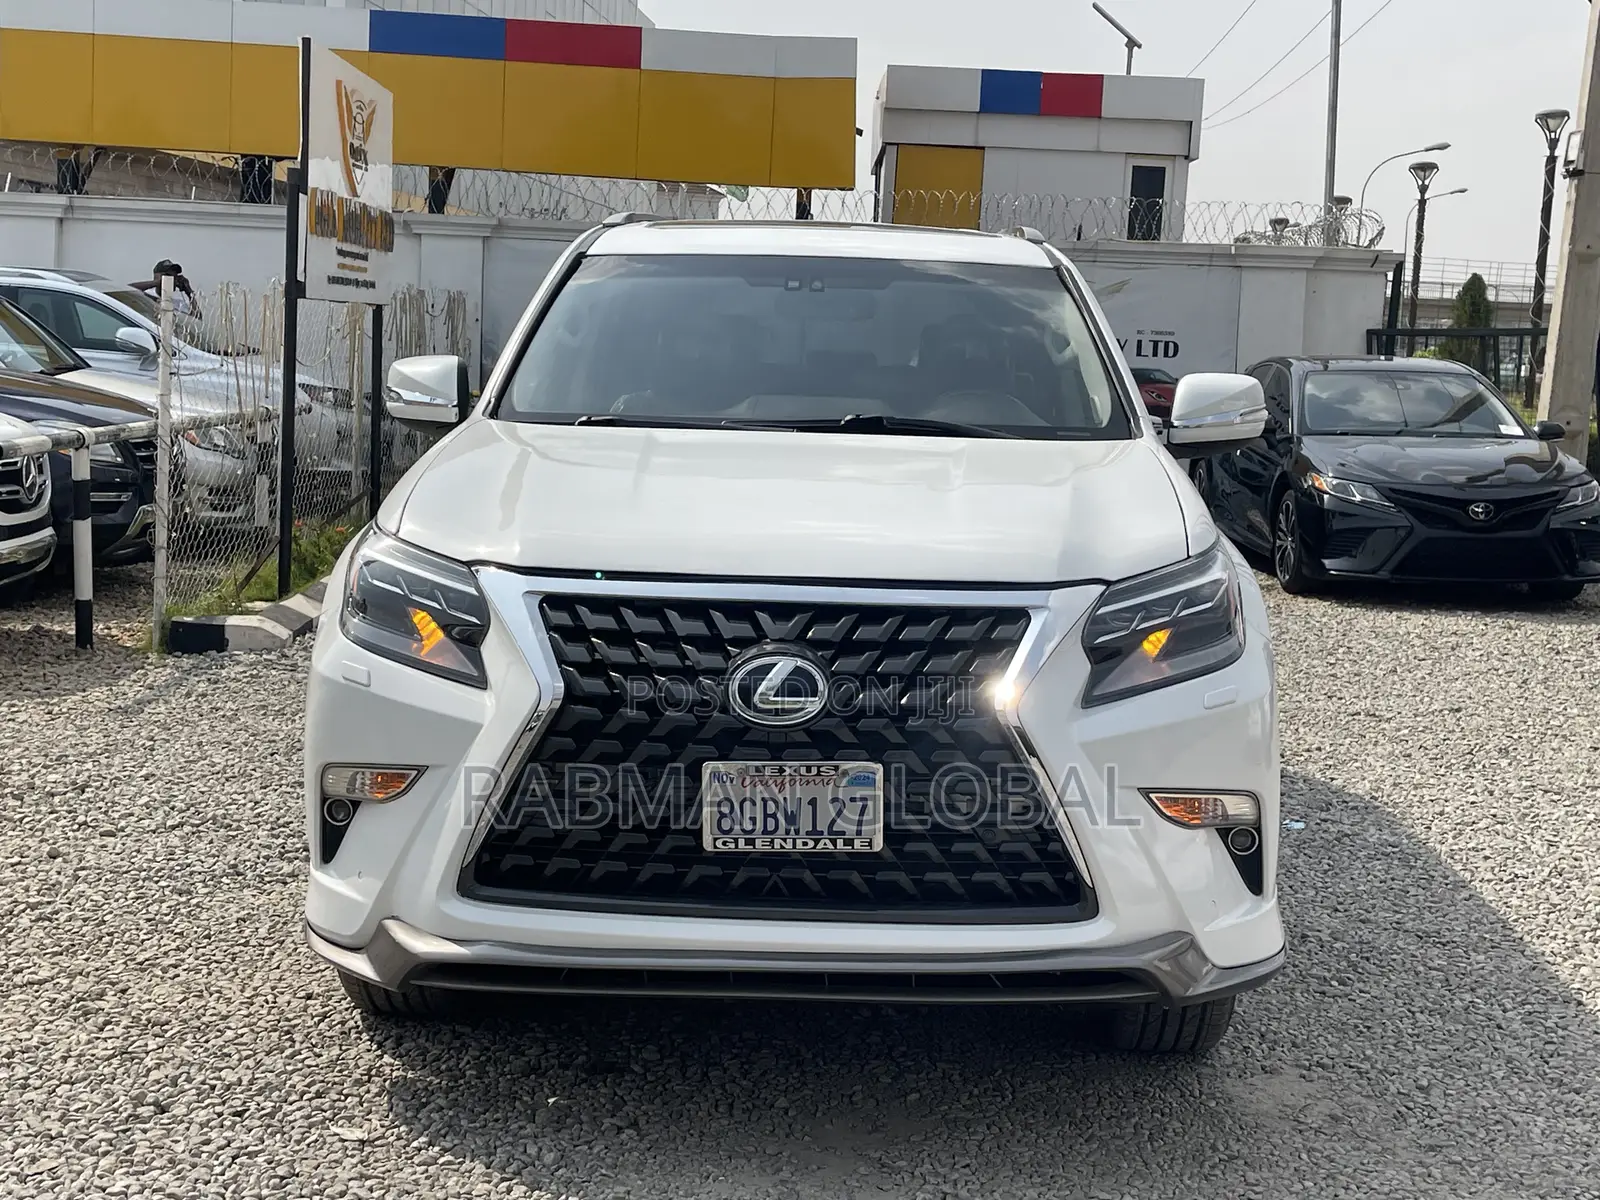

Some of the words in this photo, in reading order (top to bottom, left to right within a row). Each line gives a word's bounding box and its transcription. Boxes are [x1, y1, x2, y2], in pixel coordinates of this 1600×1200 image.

[1135, 339, 1180, 359] LTD
[748, 765, 837, 777] LEXUS
[852, 773, 871, 782] 2024
[716, 796, 868, 836] 8GBW127
[714, 837, 872, 850] GLENDALE
